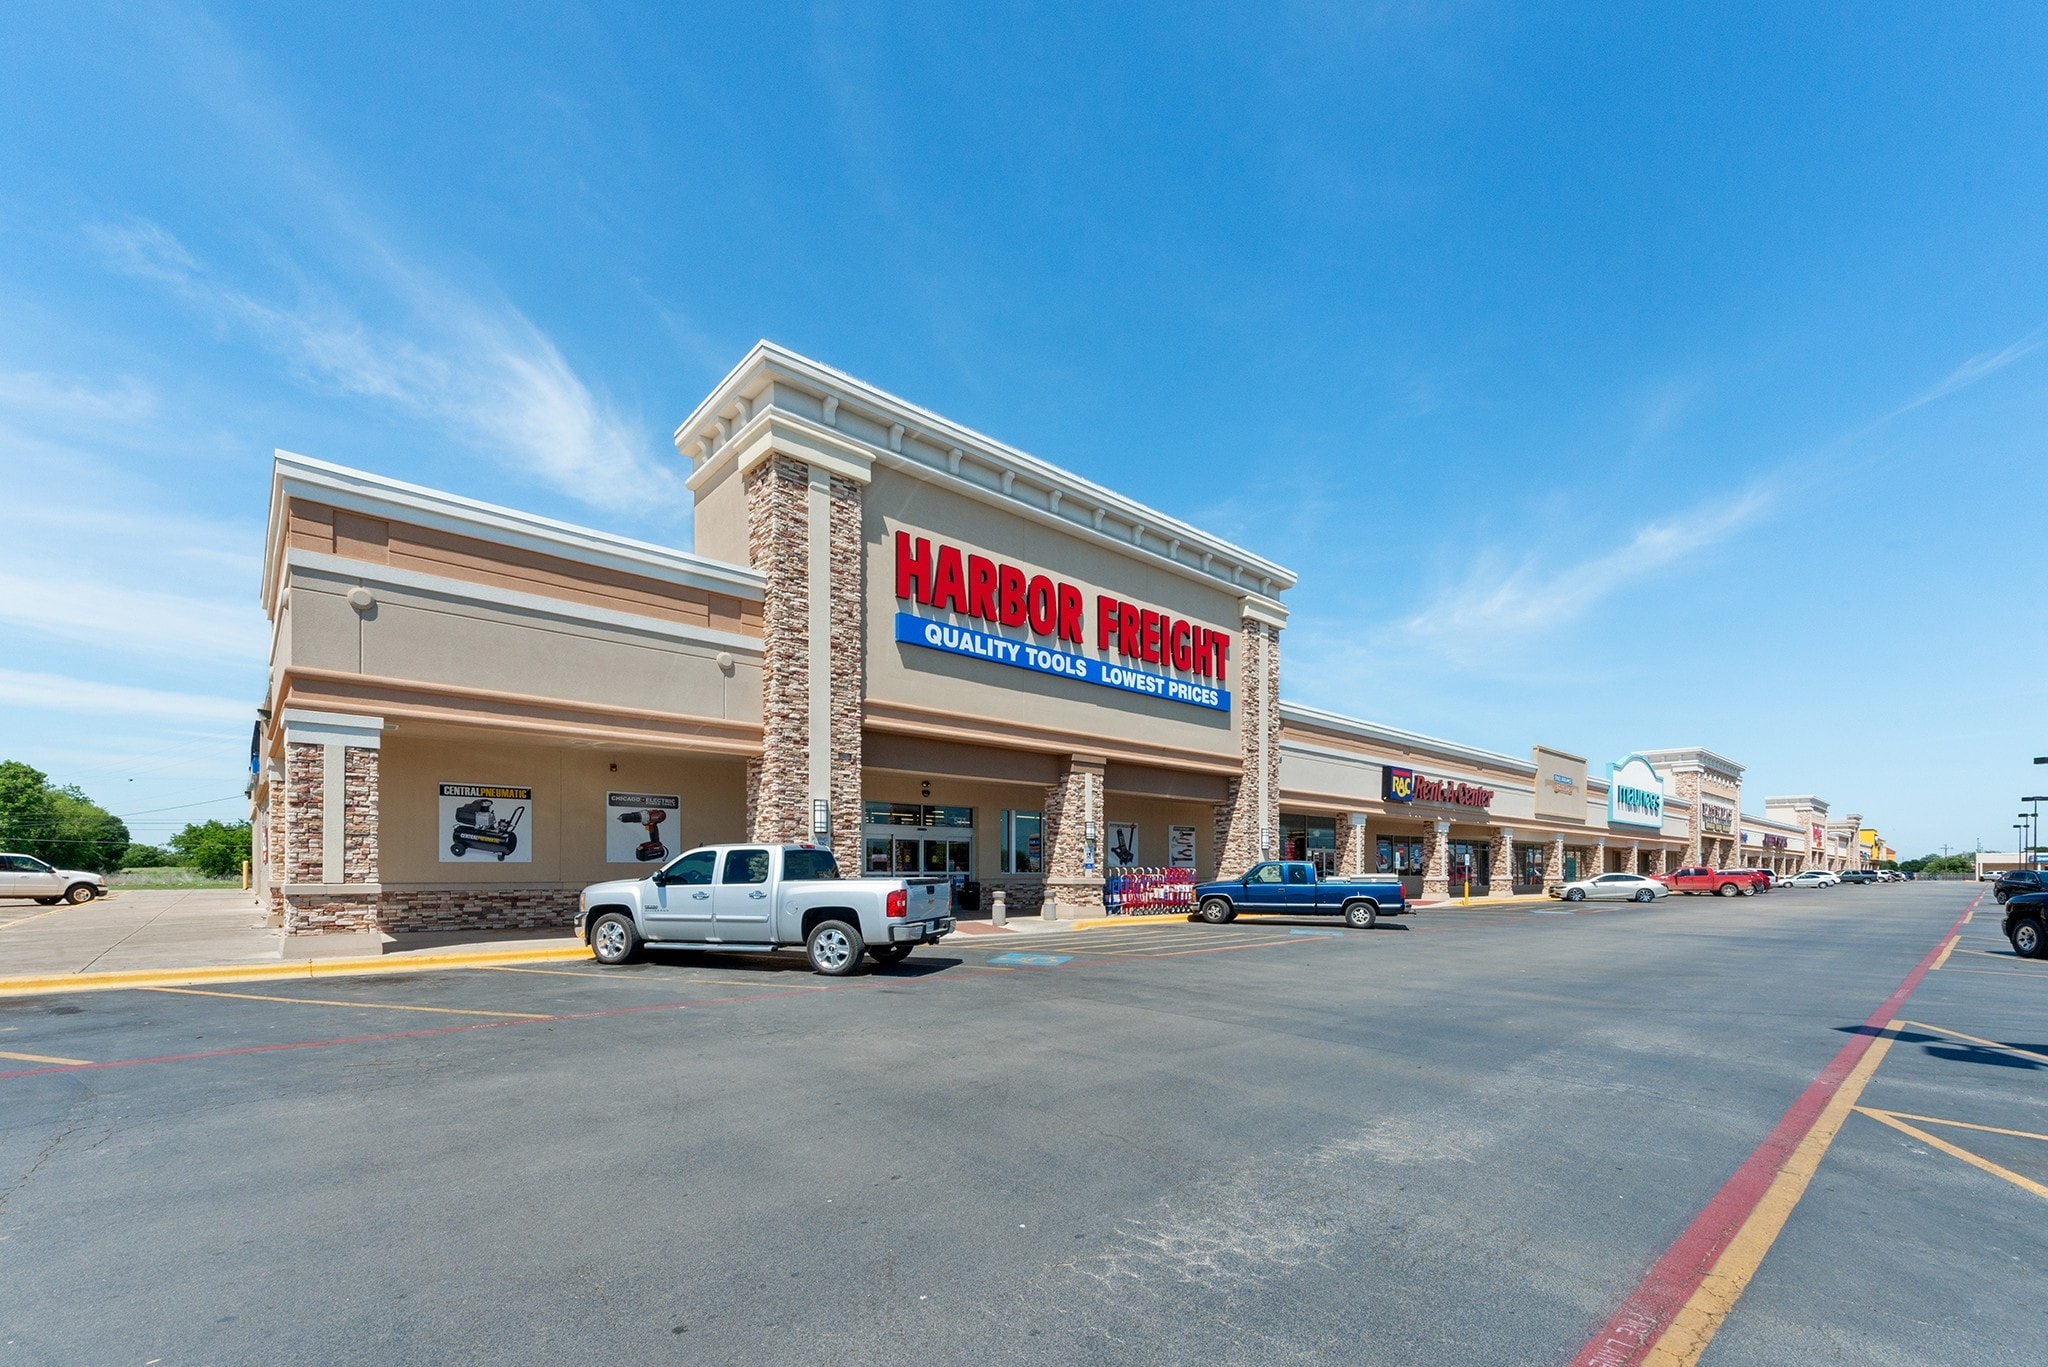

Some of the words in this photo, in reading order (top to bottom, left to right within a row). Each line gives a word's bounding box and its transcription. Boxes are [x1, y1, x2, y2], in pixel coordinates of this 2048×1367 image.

[895, 530, 1083, 644] HARBOR
[1096, 594, 1231, 681] FREIGHT
[925, 623, 1020, 660] QUALITY
[1025, 648, 1088, 677] TOOLS
[1101, 665, 1165, 694] LOWEST
[1168, 682, 1219, 706] PRICES
[611, 795, 640, 803] CHICAGO
[1392, 776, 1411, 798] RAC
